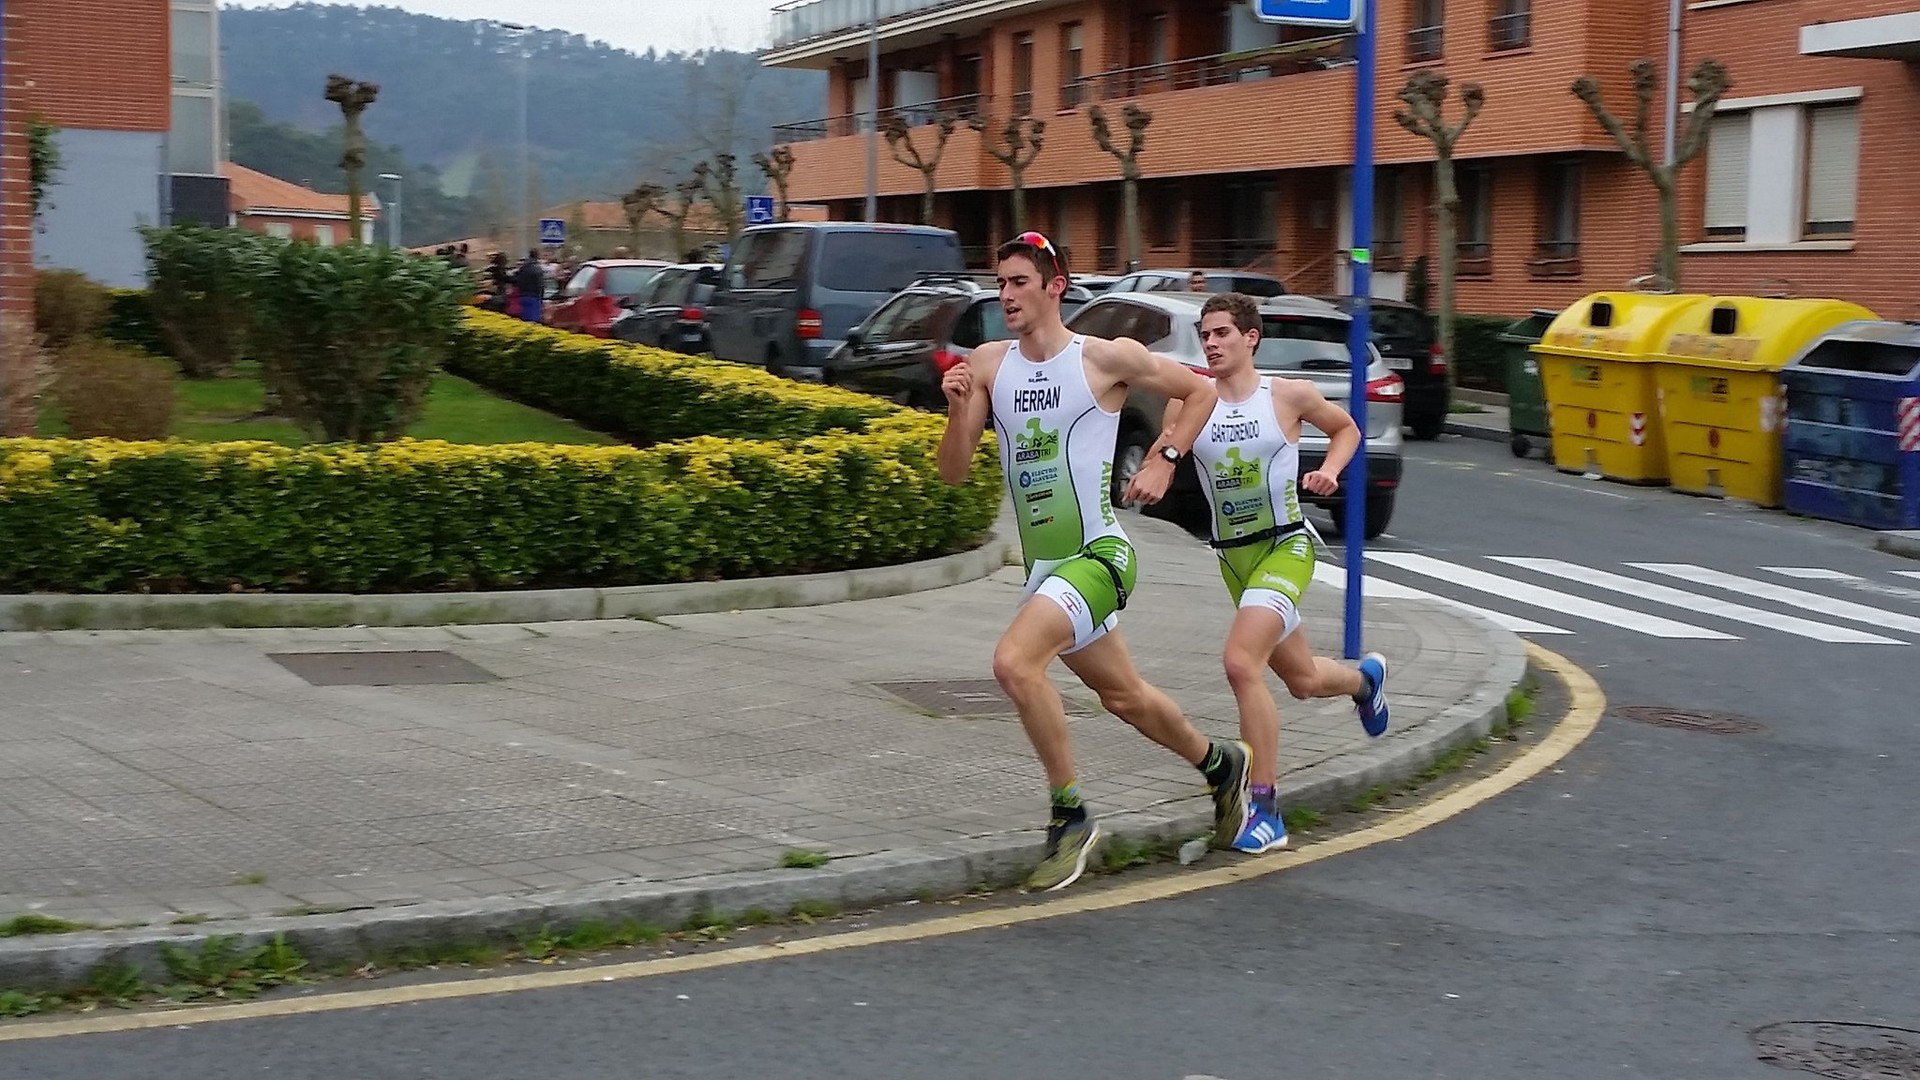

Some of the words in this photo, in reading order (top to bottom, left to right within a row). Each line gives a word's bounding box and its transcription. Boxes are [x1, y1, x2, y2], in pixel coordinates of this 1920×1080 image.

[1014, 385, 1061, 413] HERRAN
[1017, 450, 1040, 461] ARABA
[1040, 448, 1051, 457] TRI
[1031, 466, 1058, 477] ELECTRO
[1101, 460, 1116, 527] ARABA
[1285, 479, 1301, 523] ARAB
[1114, 543, 1129, 573] TRI
